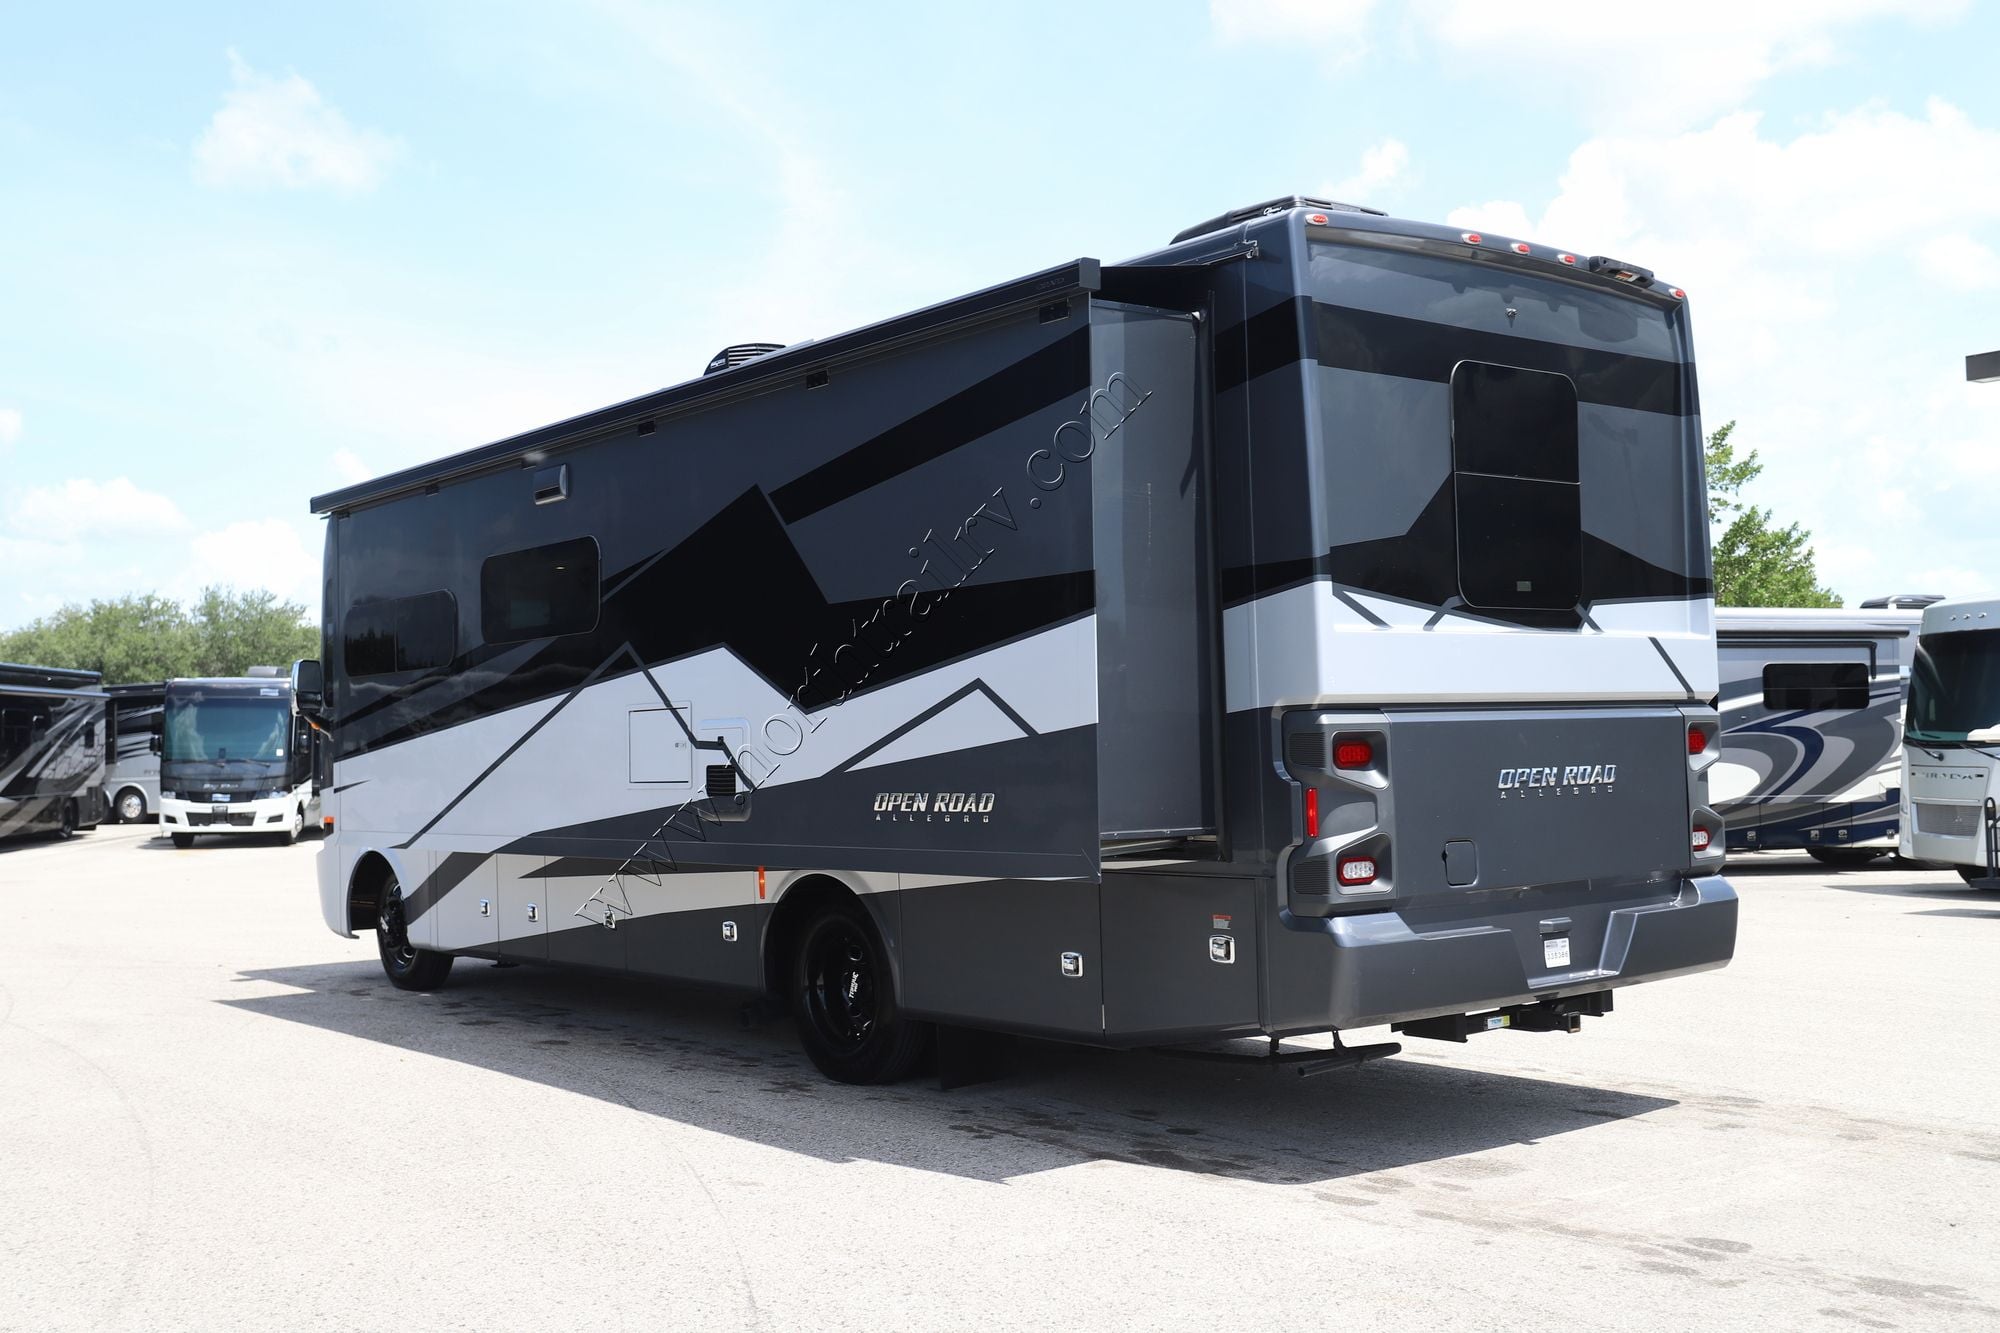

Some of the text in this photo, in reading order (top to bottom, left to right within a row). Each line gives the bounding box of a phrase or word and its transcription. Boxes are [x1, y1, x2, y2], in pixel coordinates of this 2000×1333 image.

[1498, 764, 1617, 789] OPEN ROAD
[1500, 786, 1614, 799] ALLEGRO
[873, 792, 995, 813] OPEN ROAD
[875, 814, 990, 823] ALLEGRO
